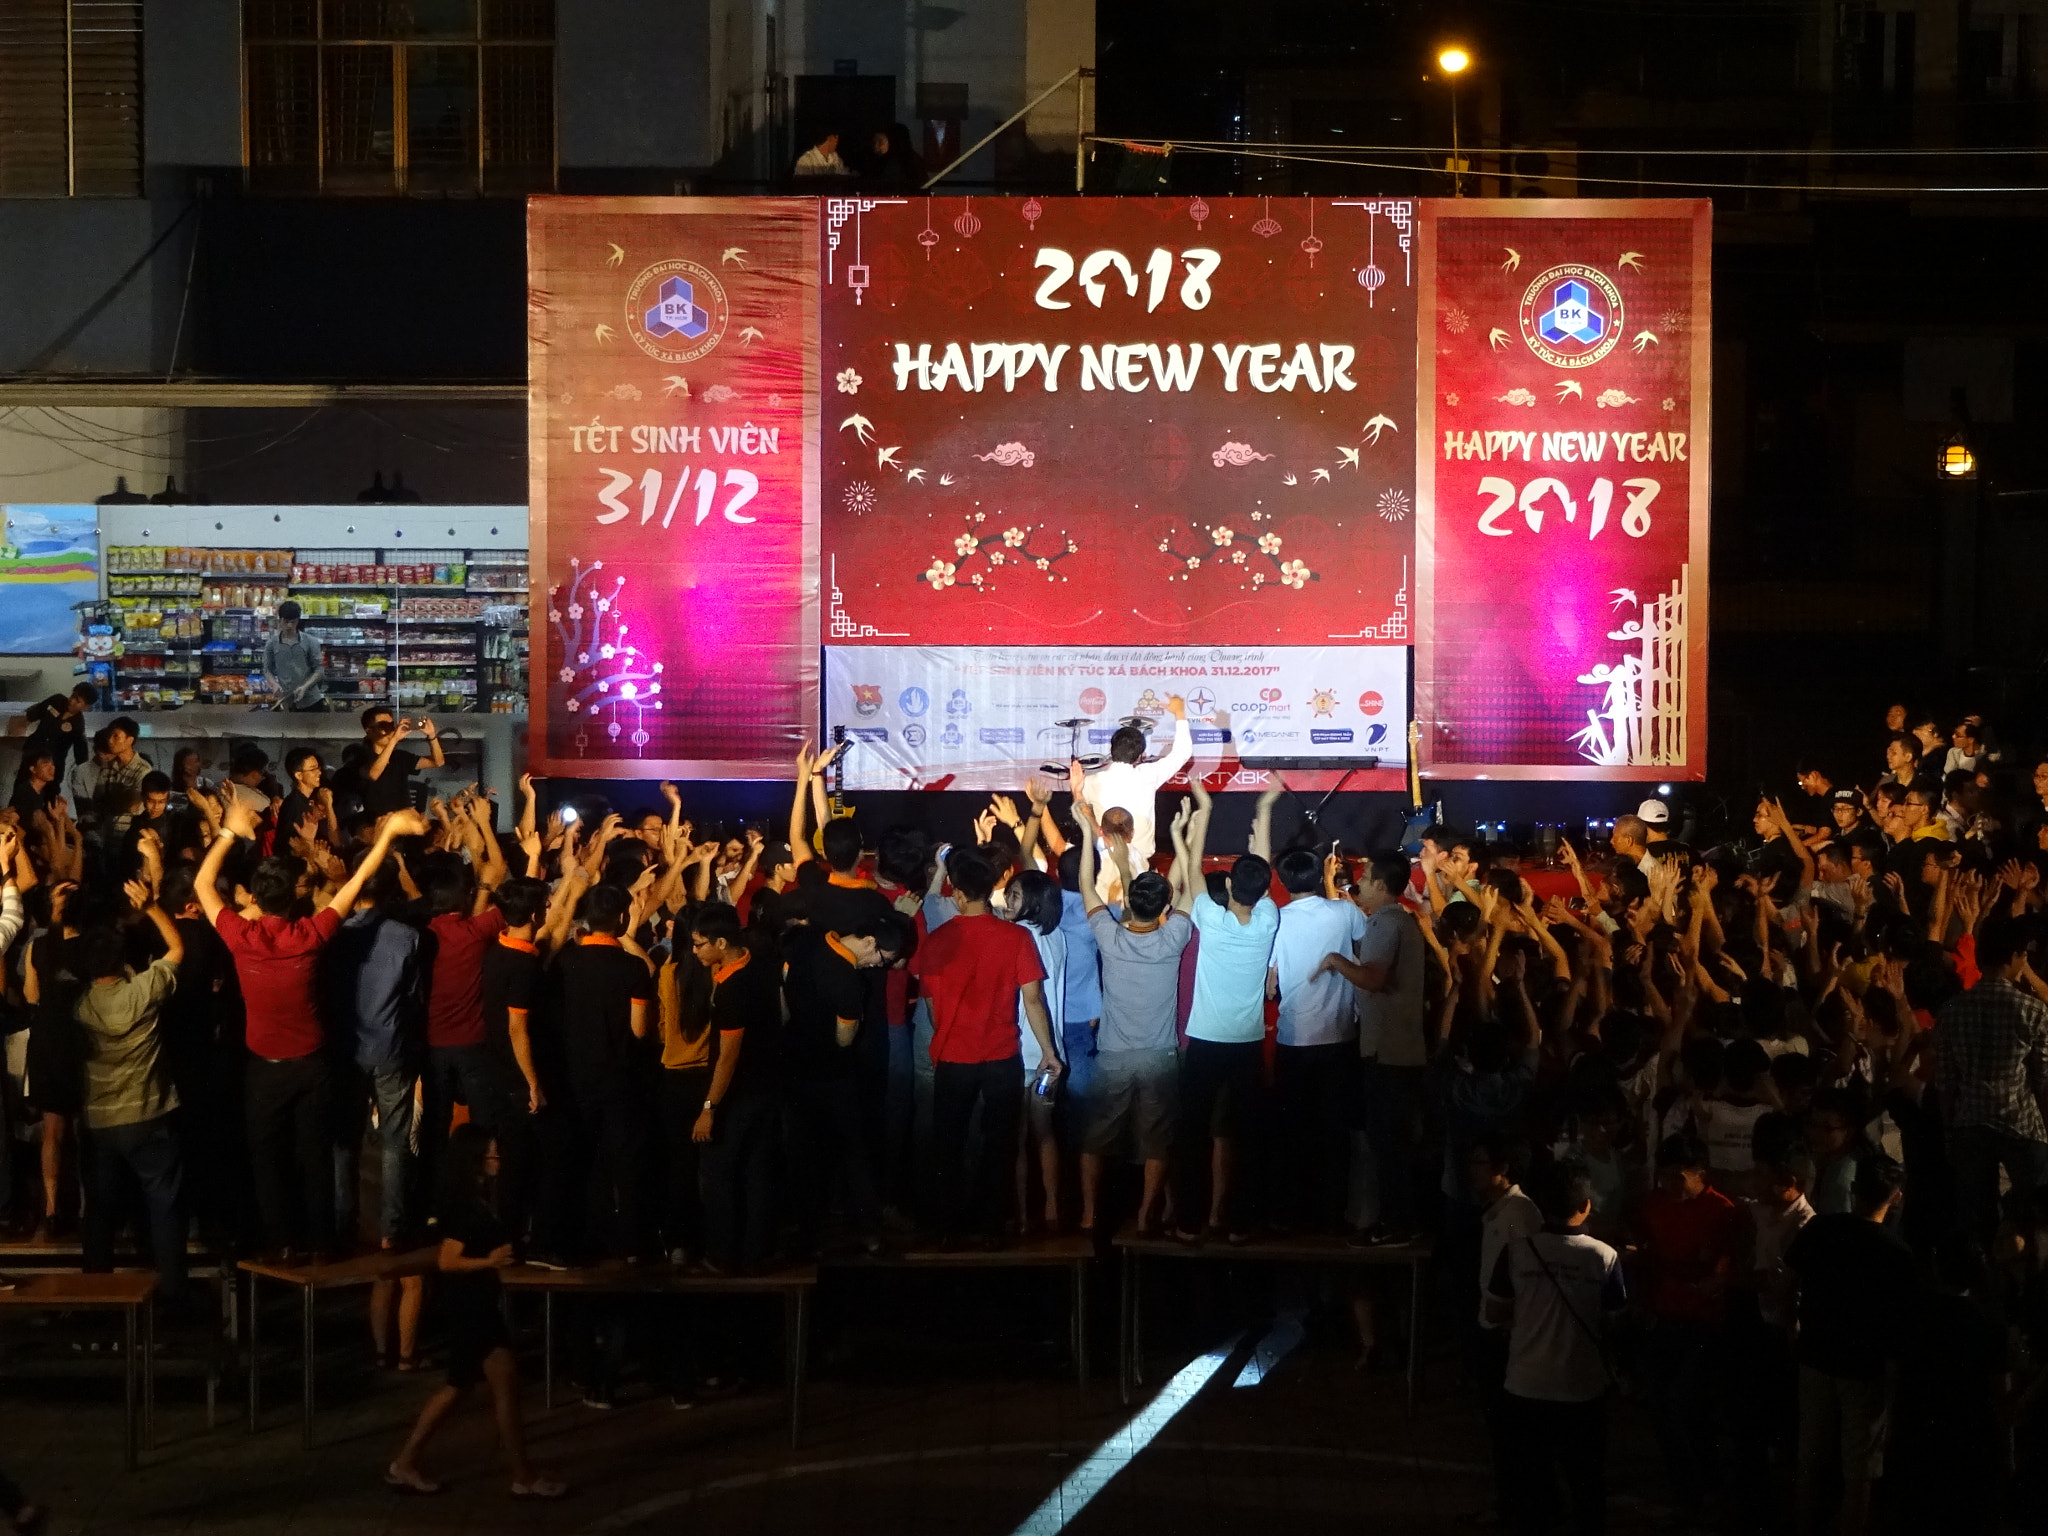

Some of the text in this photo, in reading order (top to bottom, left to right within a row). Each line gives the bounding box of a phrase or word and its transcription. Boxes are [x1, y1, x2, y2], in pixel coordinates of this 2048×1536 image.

[688, 264, 710, 281] BÁCH
[708, 279, 723, 303] KHOA
[1034, 247, 1221, 313] 2018
[1548, 269, 1563, 279] ĐẠI
[1564, 267, 1583, 276] HỌC
[1584, 269, 1606, 287] BÁCH
[1603, 284, 1618, 308] KHOA
[664, 303, 687, 315] BK
[1560, 309, 1581, 319] BK
[644, 343, 660, 356] TÚC
[675, 350, 699, 361] BÁCH
[700, 333, 720, 354] KHOA
[1539, 347, 1555, 362] TÚC
[1569, 355, 1594, 366] BÁCH
[1594, 338, 1615, 359] KHOA
[893, 342, 1357, 393] HAPPY NEW YEAR
[569, 415, 779, 454] TẾT SINH VIÊN
[1444, 430, 1687, 463] HAPPY NEW YEAR
[596, 465, 759, 529] 31/12
[1476, 476, 1661, 541] 2018
[1057, 664, 1074, 676] KÝ
[1078, 664, 1105, 676] TÚC
[1108, 664, 1127, 676] XÁ
[1130, 664, 1167, 676] BÁCH
[1170, 666, 1208, 676] KHOA
